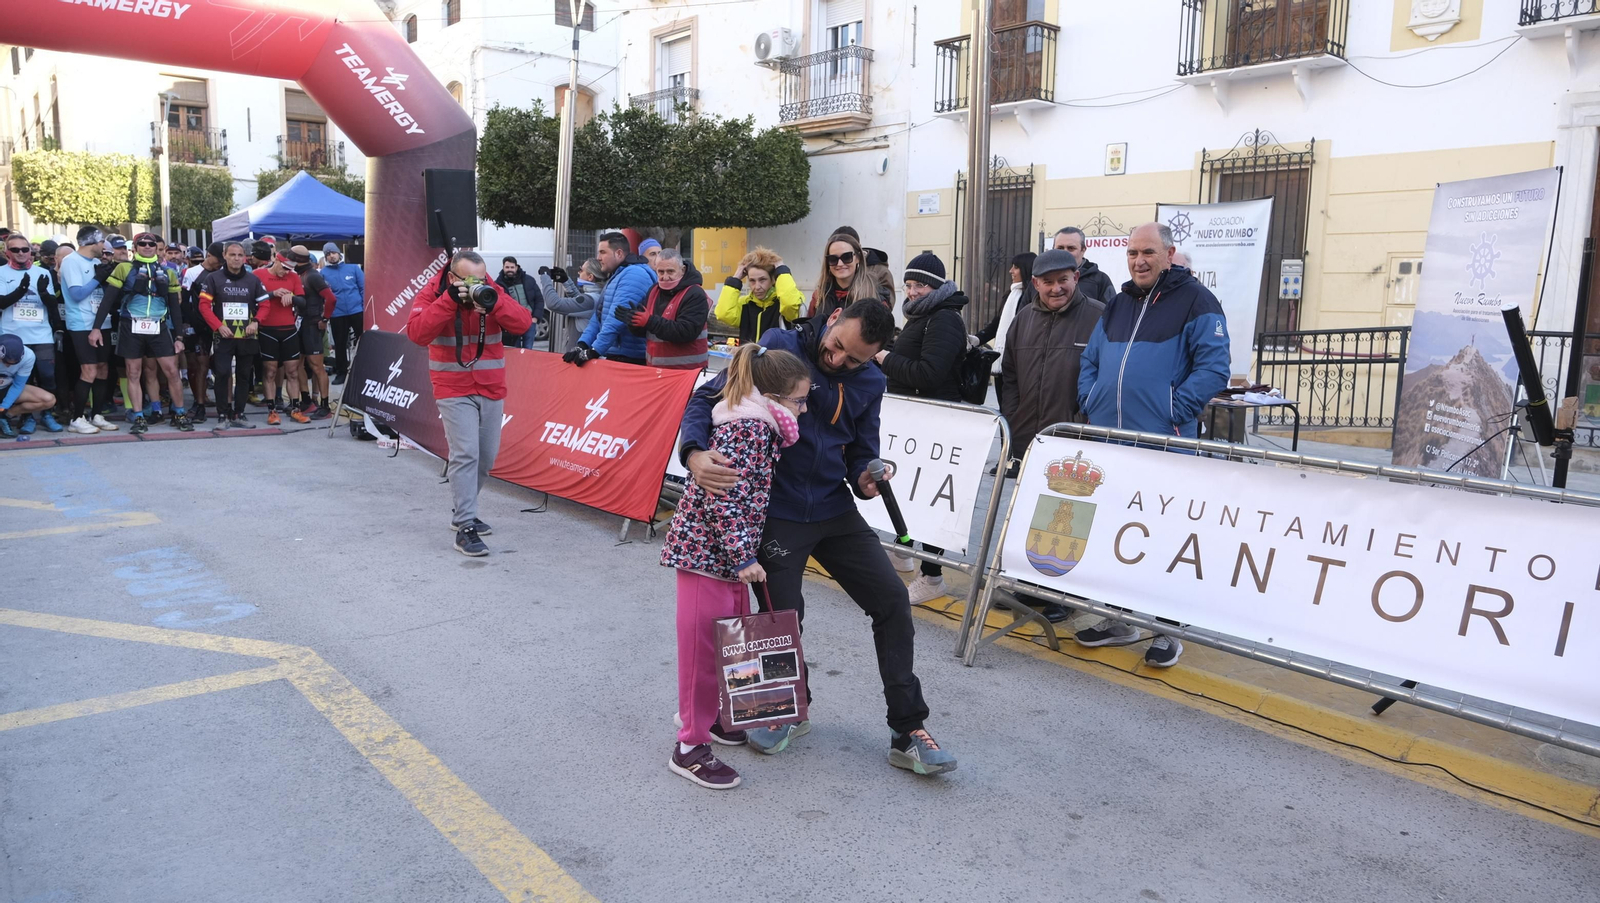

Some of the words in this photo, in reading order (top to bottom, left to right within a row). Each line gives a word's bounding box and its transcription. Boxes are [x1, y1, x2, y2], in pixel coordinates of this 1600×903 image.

[334, 43, 426, 135] TEAMERGY
[1502, 191, 1513, 203] UN
[1514, 188, 1545, 202] FUTURO
[1464, 212, 1475, 223] SIN
[1476, 208, 1519, 222] ADICCIONES
[1085, 238, 1128, 248] UNCIOS
[1454, 291, 1474, 305] Nuevo
[1477, 292, 1501, 306] Rumbo
[19, 309, 38, 317] 358
[141, 321, 151, 330] 87
[361, 379, 419, 409] TEAMERGY
[540, 421, 637, 460] TEAMERGY
[930, 443, 962, 465] DE
[1127, 490, 1557, 581] AYUNTAMIENTO
[1113, 521, 1575, 657] CANTORI
[746, 635, 793, 652] CANTORIA!
